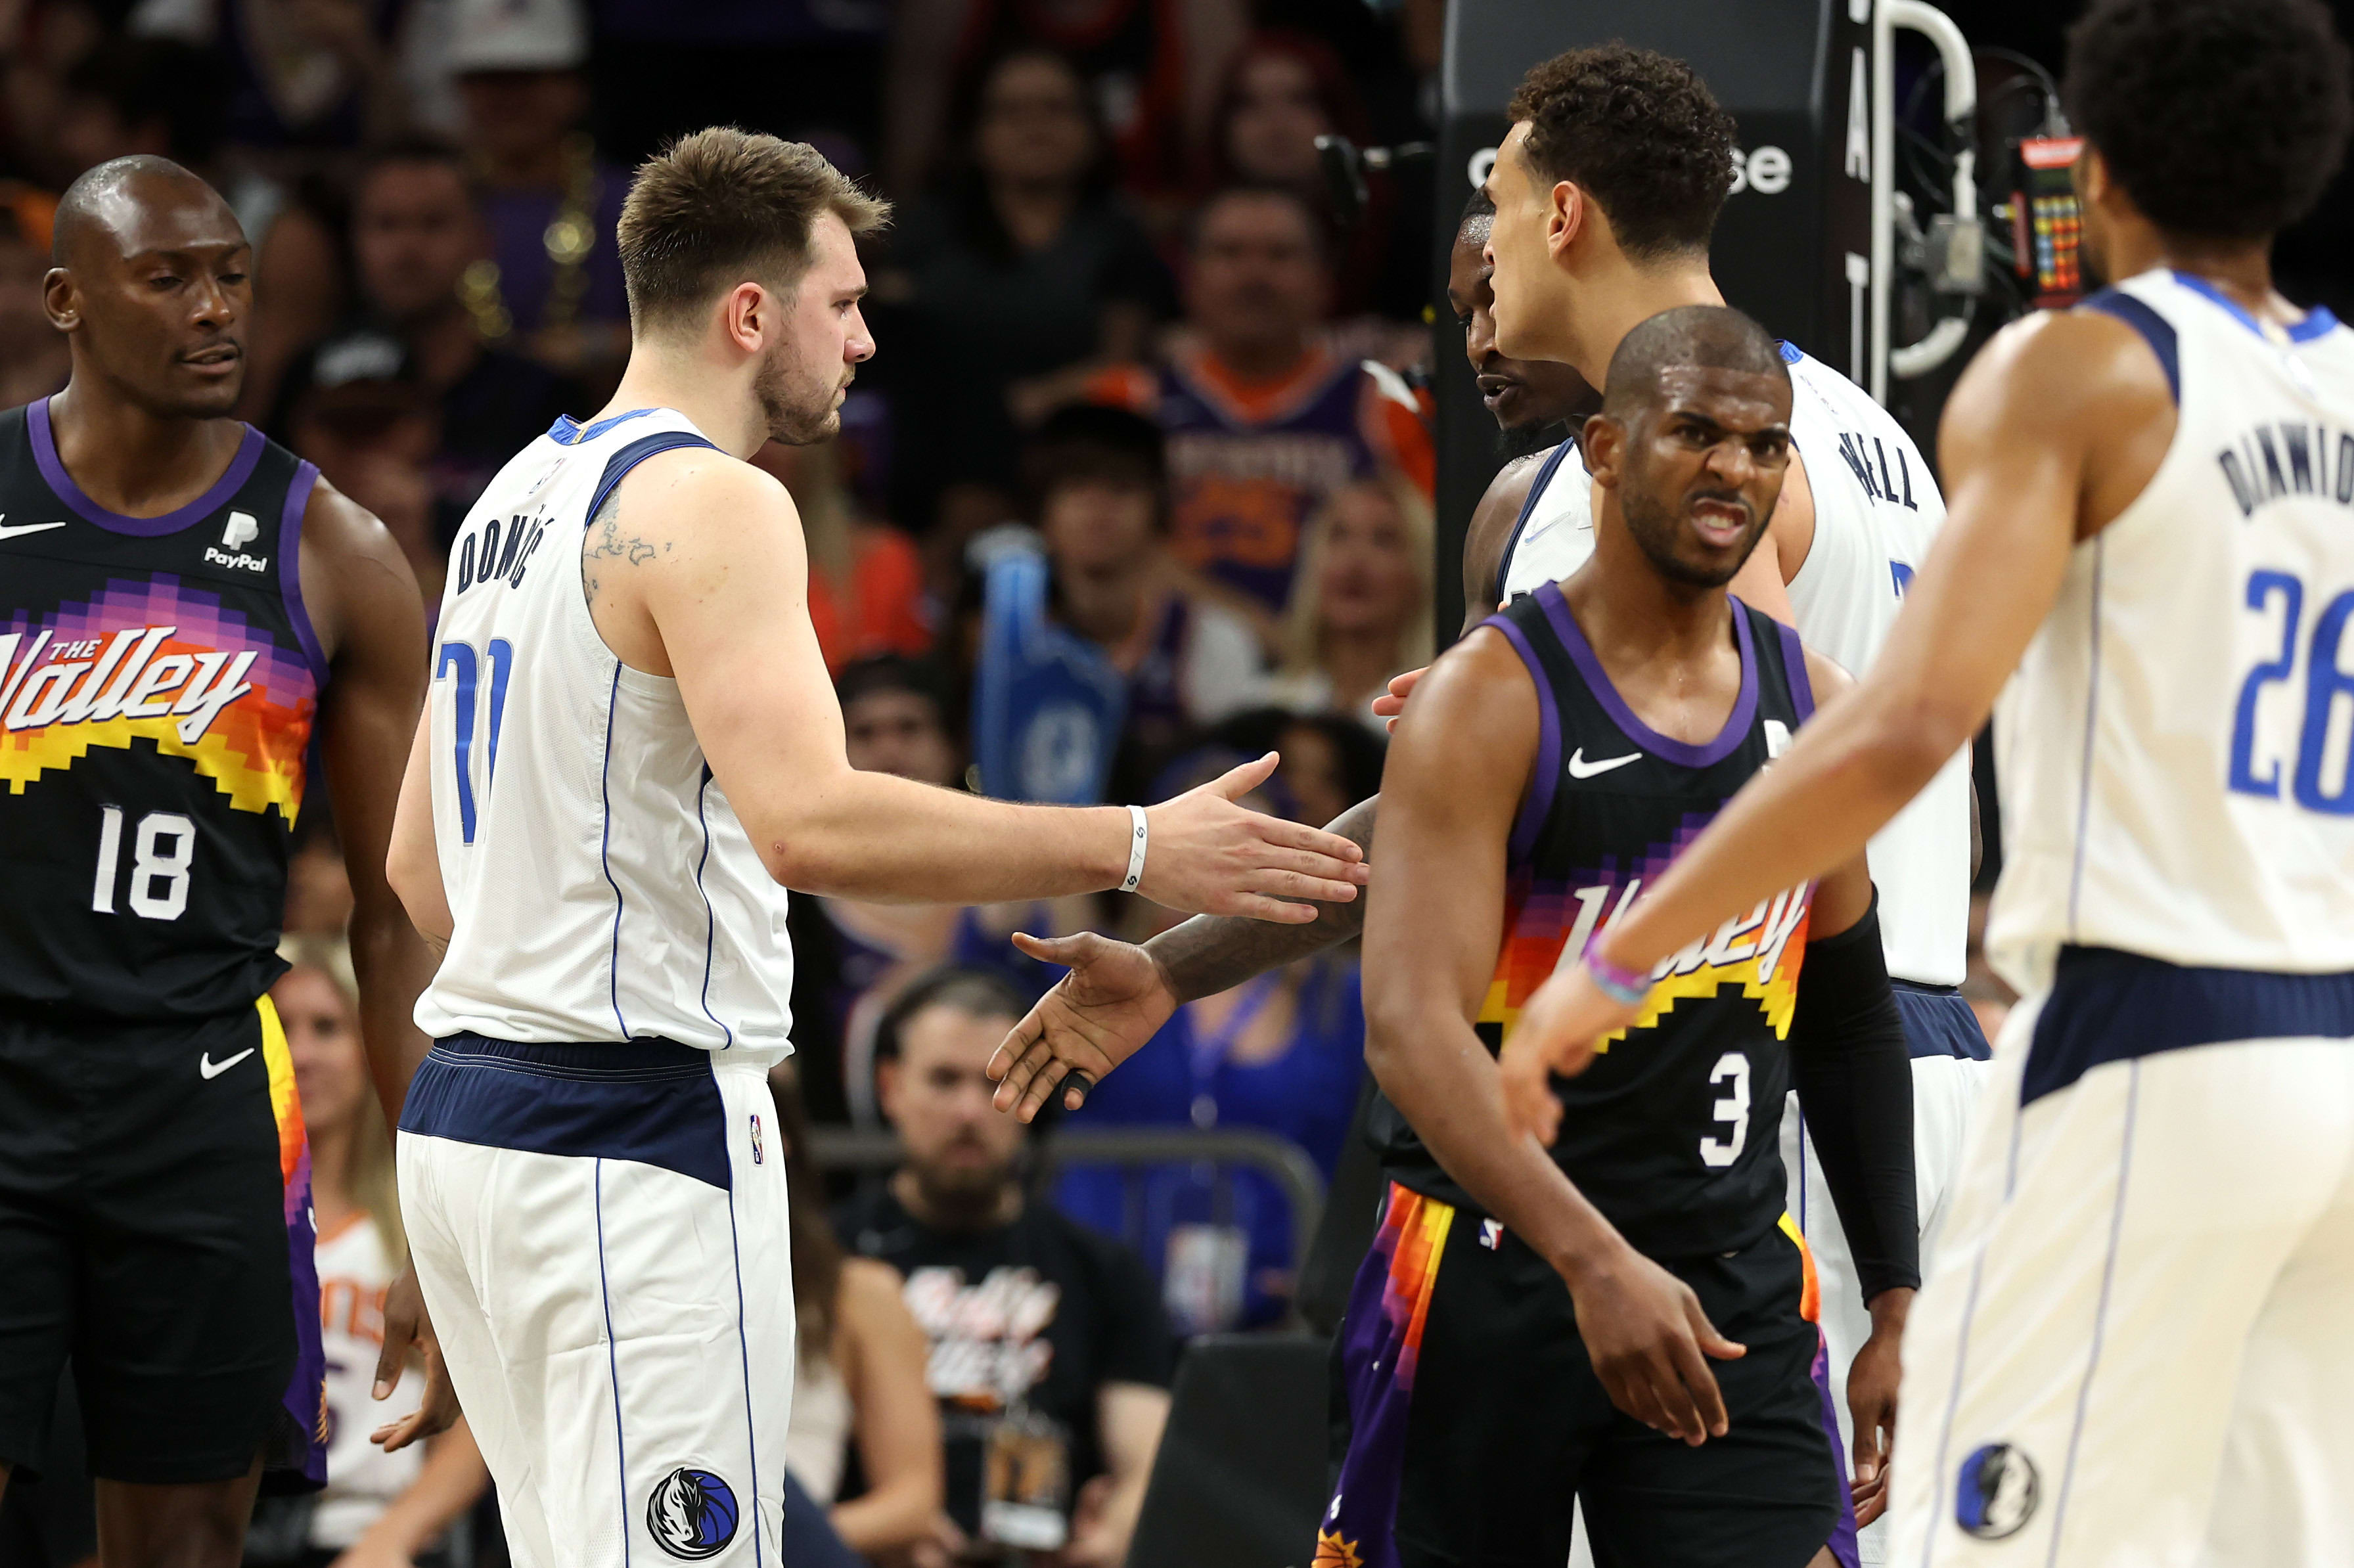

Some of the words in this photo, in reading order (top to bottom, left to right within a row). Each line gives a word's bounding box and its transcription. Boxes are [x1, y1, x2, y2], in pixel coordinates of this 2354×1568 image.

[204, 547, 268, 573] PayPal
[0, 625, 259, 746] Valley
[49, 638, 102, 661] THE
[2228, 568, 2354, 816] 26
[93, 805, 196, 921] 18
[1699, 1052, 1752, 1167] 3
